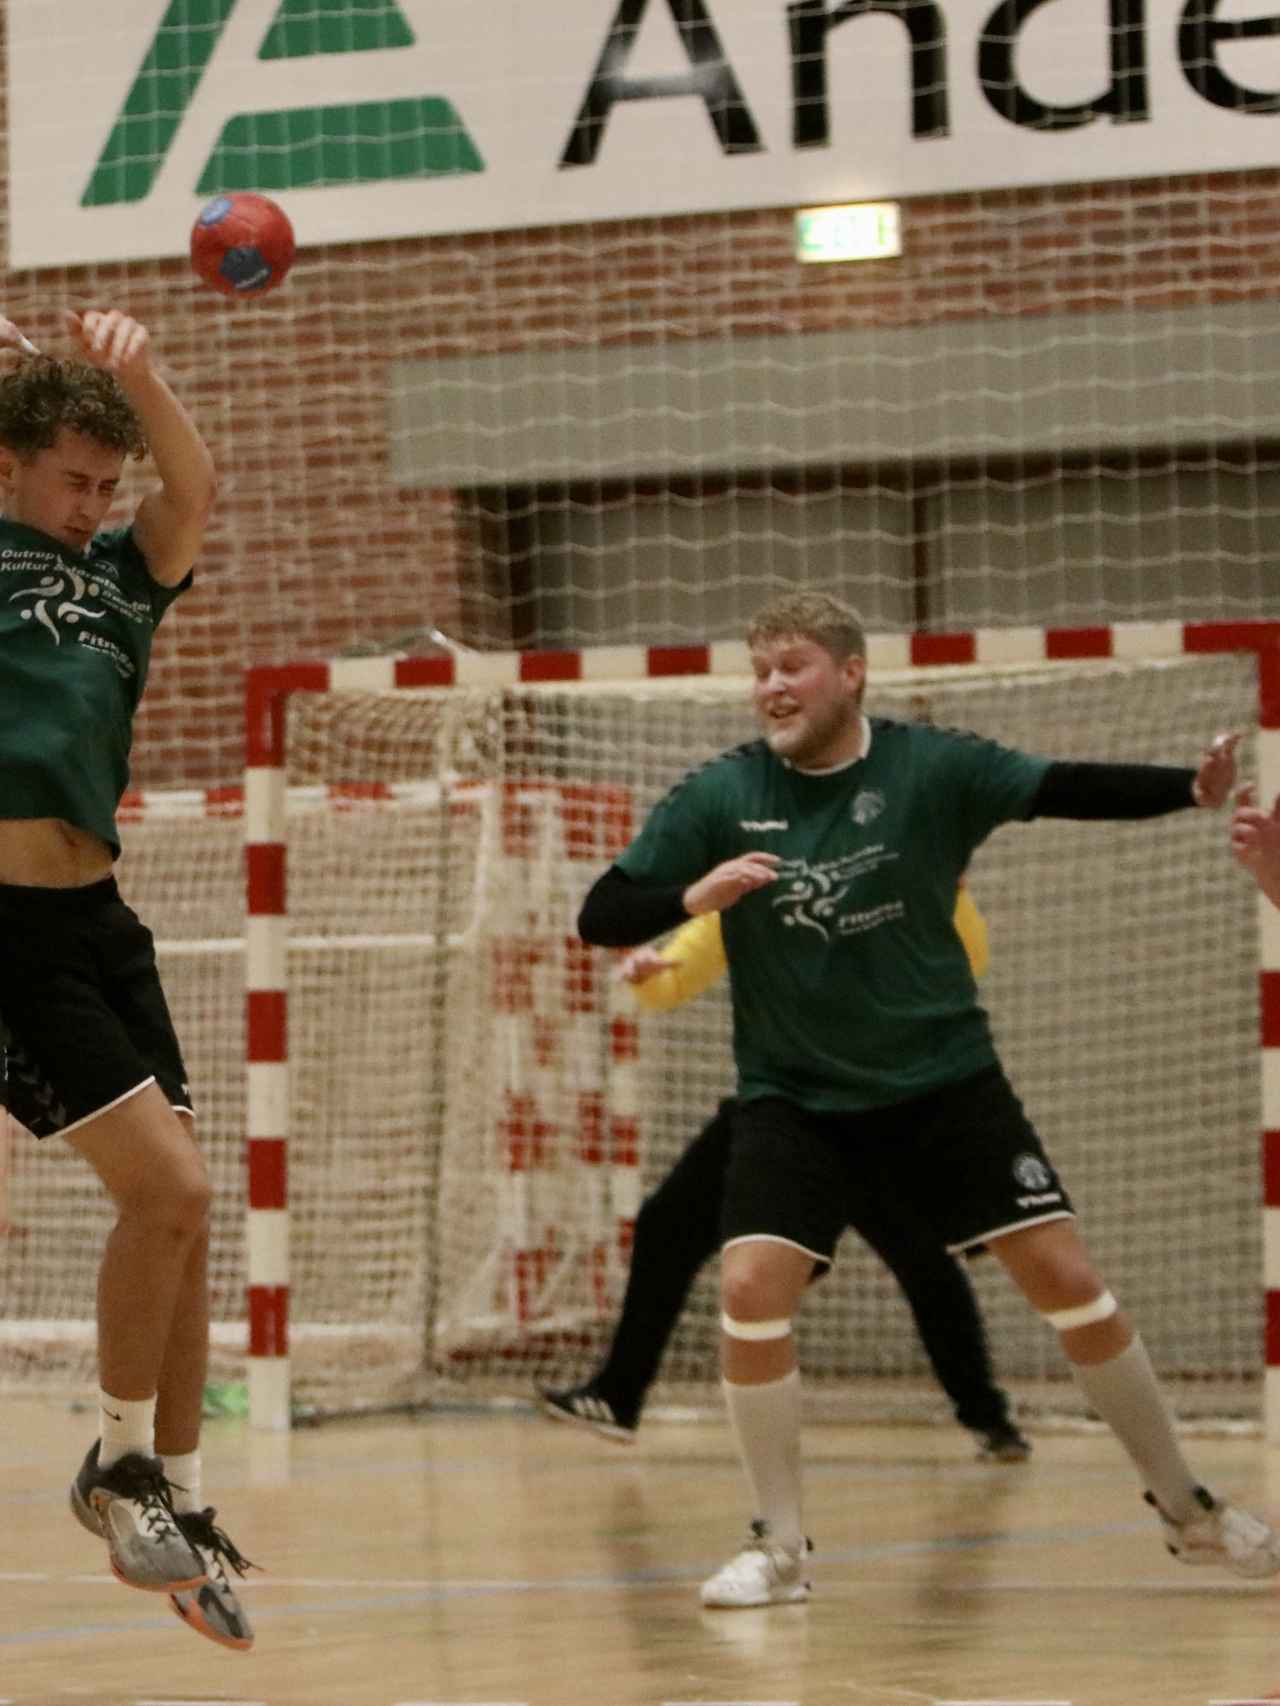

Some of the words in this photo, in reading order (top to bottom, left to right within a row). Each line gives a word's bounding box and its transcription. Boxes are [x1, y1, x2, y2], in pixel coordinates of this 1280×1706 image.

[557, 0, 1280, 170] Ande
[0, 548, 55, 560] Outrup
[0, 560, 49, 572] Kultur
